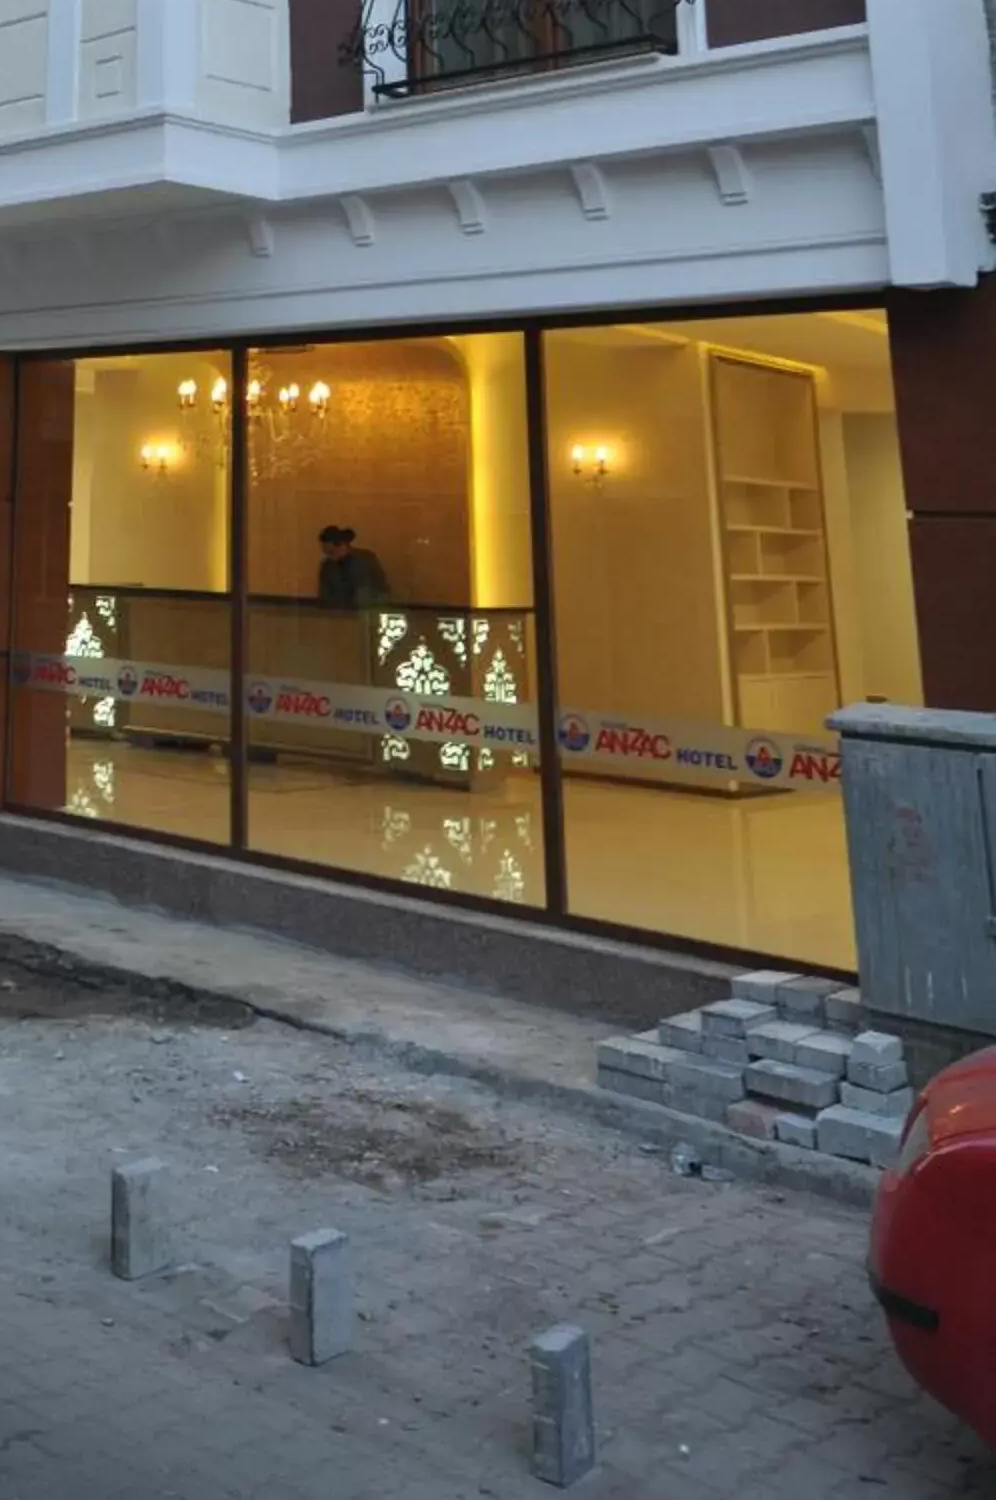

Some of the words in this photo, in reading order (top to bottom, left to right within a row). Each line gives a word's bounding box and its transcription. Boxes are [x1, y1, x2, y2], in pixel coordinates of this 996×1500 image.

[275, 691, 332, 717] ANZAC
[333, 707, 380, 725] HOTEL
[415, 706, 480, 736] ANZAC
[482, 724, 536, 744] HOTEL
[595, 727, 672, 760] ANZAC
[676, 747, 739, 771] HOTEL
[789, 751, 844, 783] ANZ
